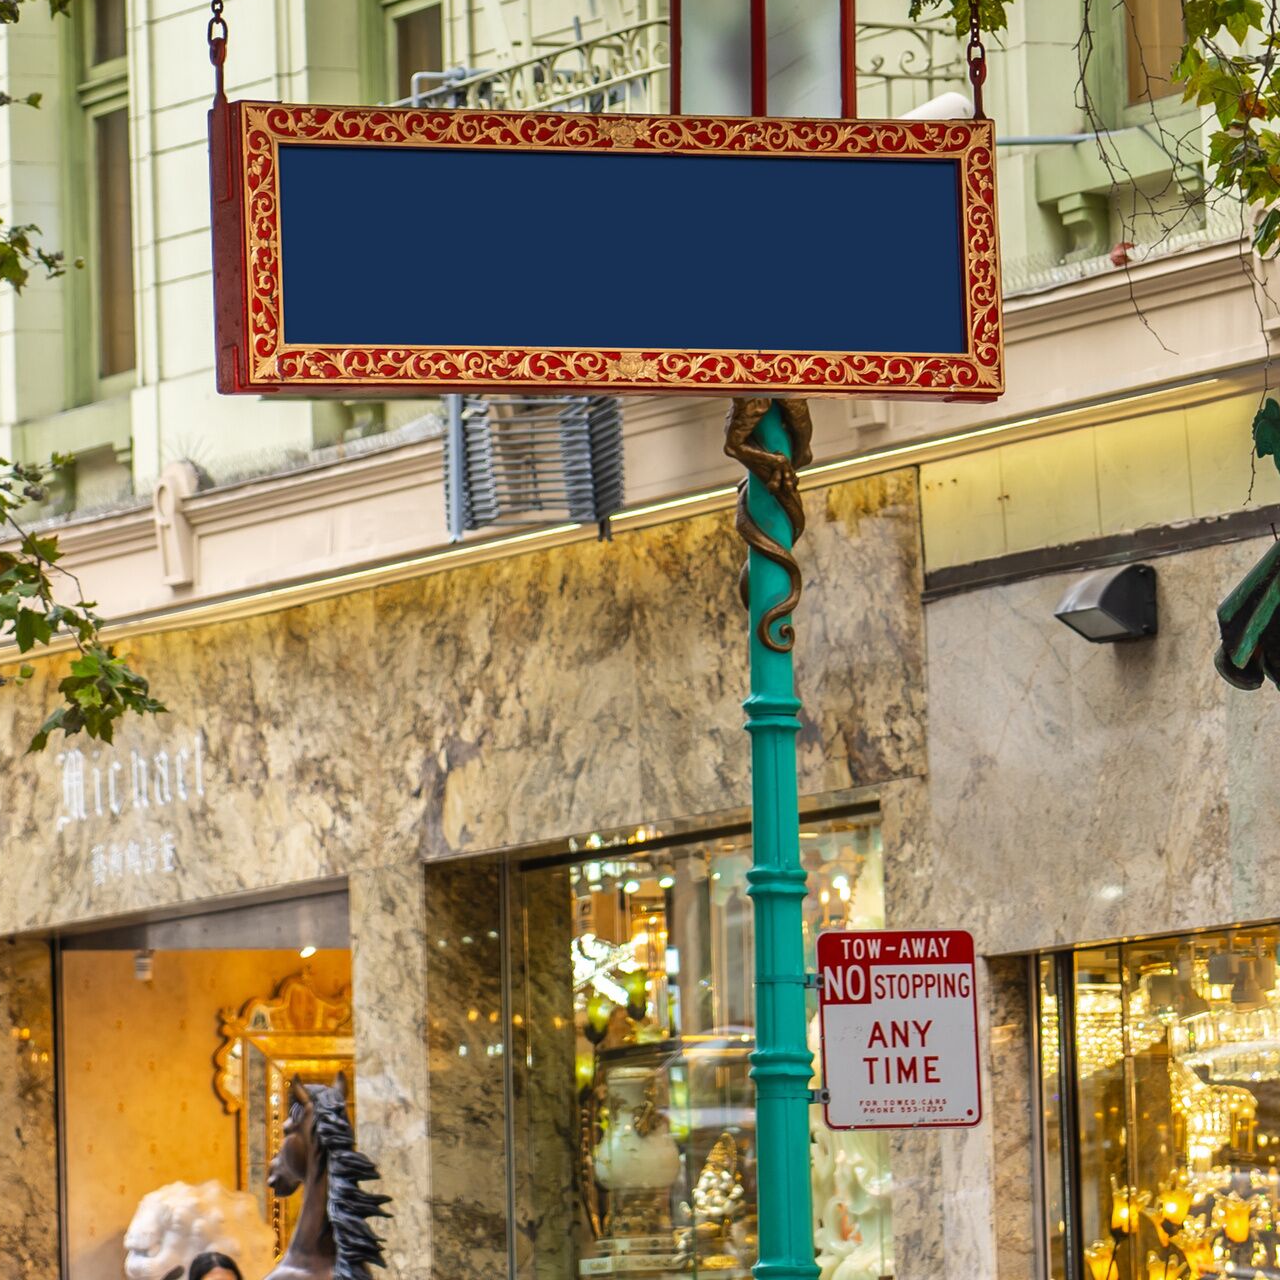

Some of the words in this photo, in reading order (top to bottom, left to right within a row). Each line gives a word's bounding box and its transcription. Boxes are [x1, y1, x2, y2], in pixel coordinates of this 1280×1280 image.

[840, 937, 951, 960] TOW-AWAY
[823, 965, 867, 1001] NO
[874, 972, 970, 1000] STOPPING
[867, 1020, 933, 1049] ANY
[863, 1055, 941, 1085] TIME
